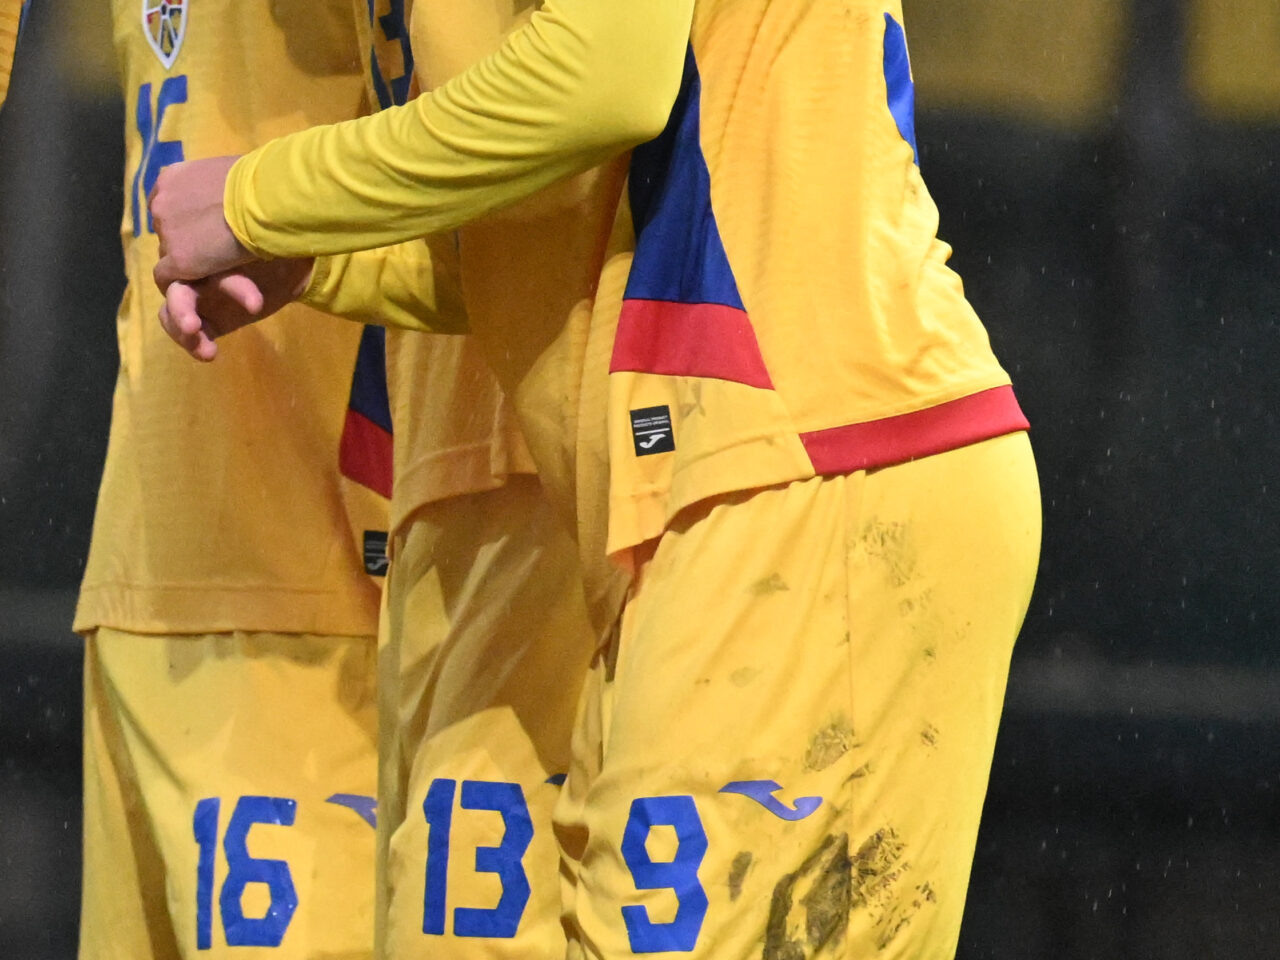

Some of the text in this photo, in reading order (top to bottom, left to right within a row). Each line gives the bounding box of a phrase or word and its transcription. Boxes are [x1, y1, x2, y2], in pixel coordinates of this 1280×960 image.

[192, 795, 299, 950] 16
[422, 778, 535, 938] 13
[621, 795, 710, 954] 9
